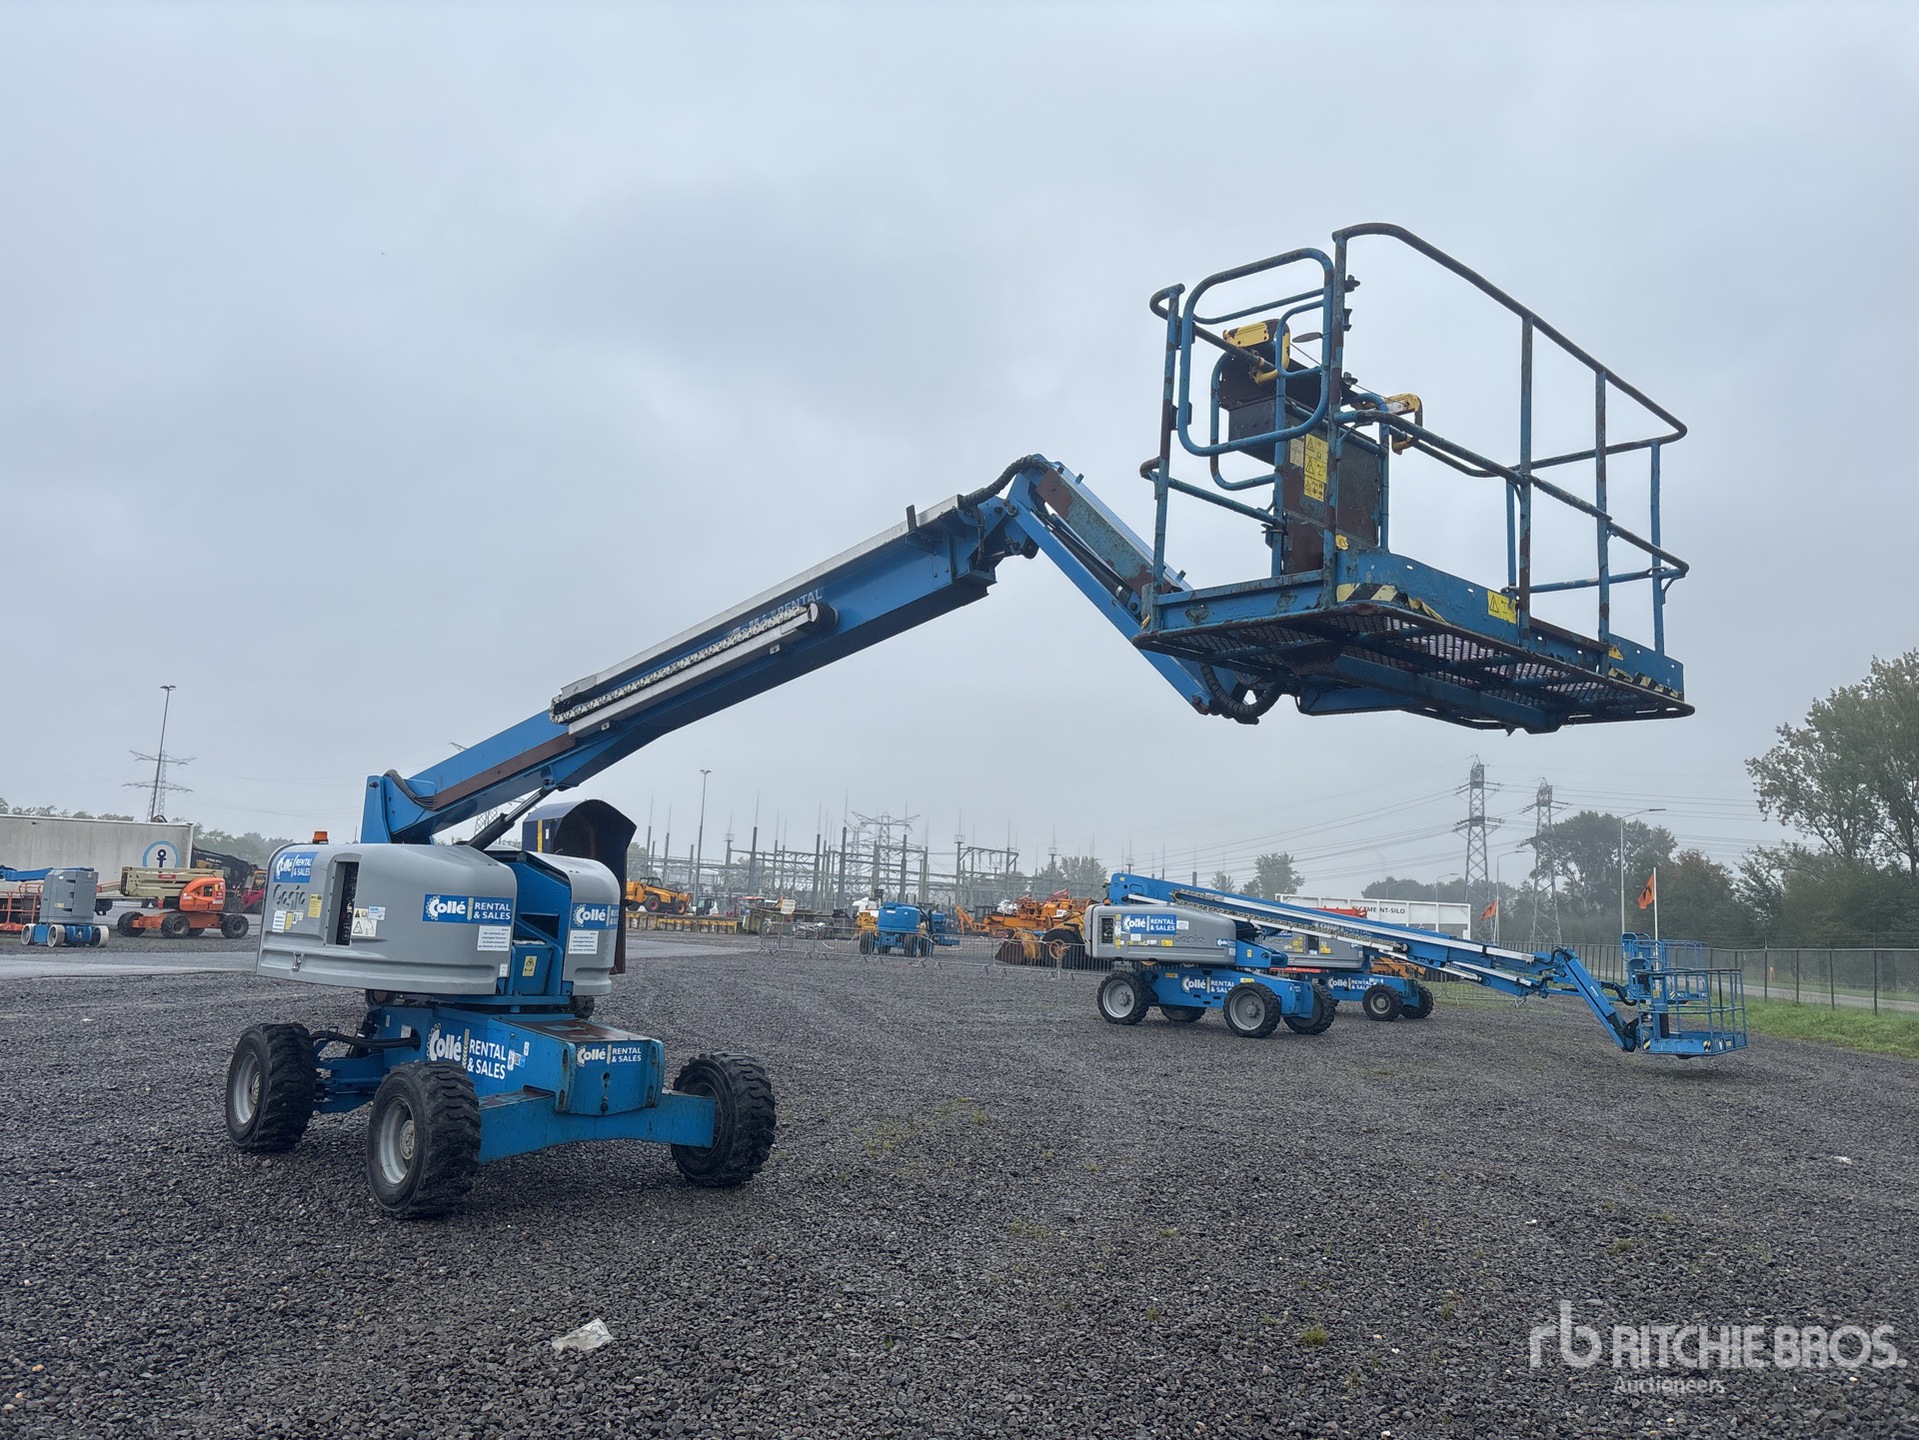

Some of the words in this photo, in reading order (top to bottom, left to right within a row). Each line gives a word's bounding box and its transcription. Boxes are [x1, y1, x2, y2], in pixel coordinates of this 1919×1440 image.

[427, 896, 467, 919] Collé
[473, 911, 480, 919] &
[474, 902, 511, 911] RENTAL
[573, 904, 606, 927] Collé
[1182, 976, 1206, 993] Collé
[1210, 979, 1235, 987] RENTAL
[427, 1023, 462, 1061] Collé
[468, 1039, 507, 1060] RENTAL
[612, 1047, 641, 1055] RENTAL
[577, 1045, 606, 1067] Collé
[618, 1054, 642, 1062] SALES
[467, 1057, 474, 1072] &
[475, 1060, 506, 1080] SALES
